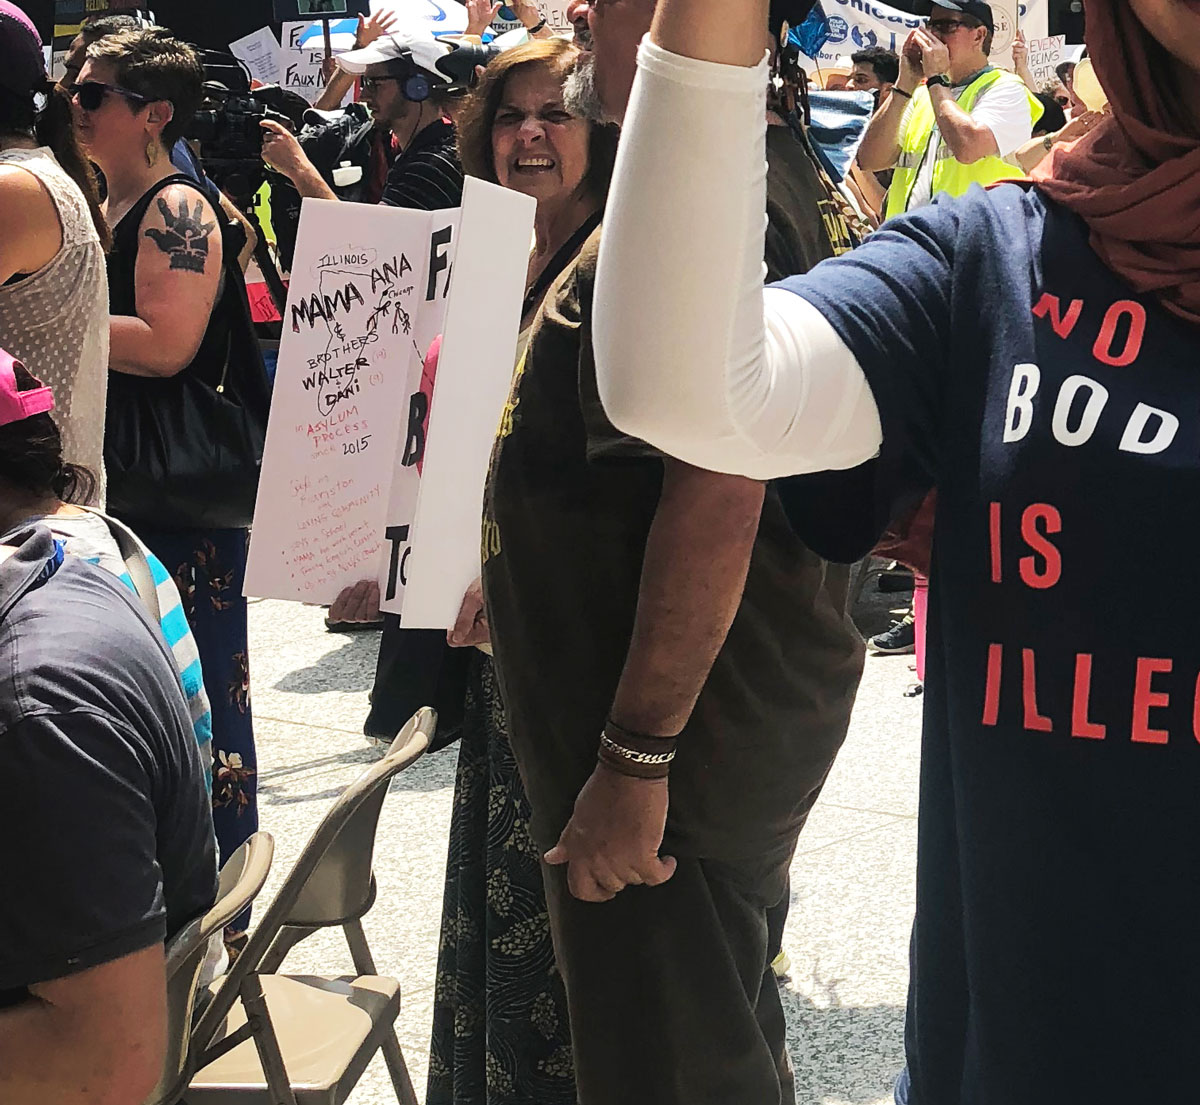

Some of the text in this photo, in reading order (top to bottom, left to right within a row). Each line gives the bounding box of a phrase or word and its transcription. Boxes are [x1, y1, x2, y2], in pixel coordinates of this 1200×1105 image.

[993, 21, 1009, 32] SE
[1030, 36, 1064, 53] EVERY
[1030, 50, 1060, 66] BEING
[286, 63, 315, 85] FAUX
[317, 253, 369, 269] ILLINOIS
[291, 280, 365, 333] MAMA
[371, 253, 412, 294] ANA
[1031, 292, 1146, 366] NO
[306, 330, 379, 370] BROTHERS
[302, 357, 370, 391] WALTER
[307, 405, 359, 437] ASYLUM
[312, 419, 369, 448] PROCESS
[342, 434, 372, 455] 2015
[990, 502, 1062, 589] IS
